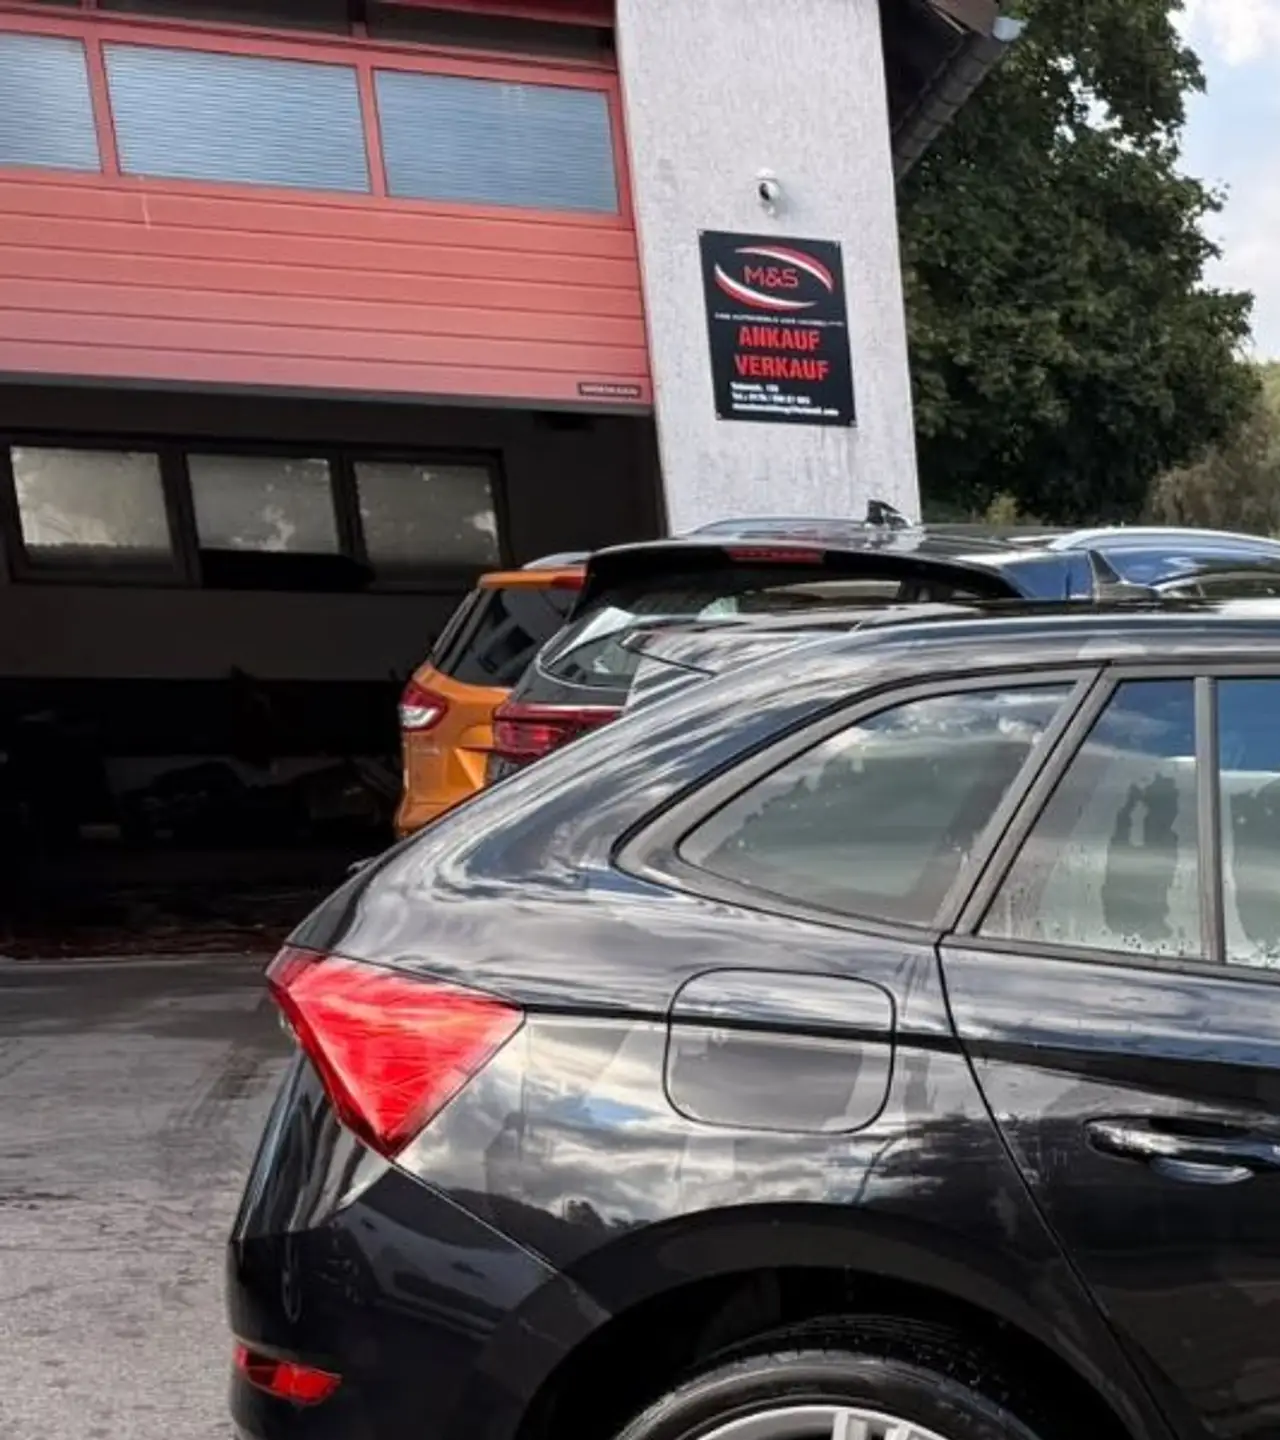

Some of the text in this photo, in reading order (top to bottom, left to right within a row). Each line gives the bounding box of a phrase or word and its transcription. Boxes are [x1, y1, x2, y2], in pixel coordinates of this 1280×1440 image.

[743, 265, 800, 290] M&S
[738, 325, 822, 351] ANKAUF
[733, 353, 830, 381] VERKAUF
